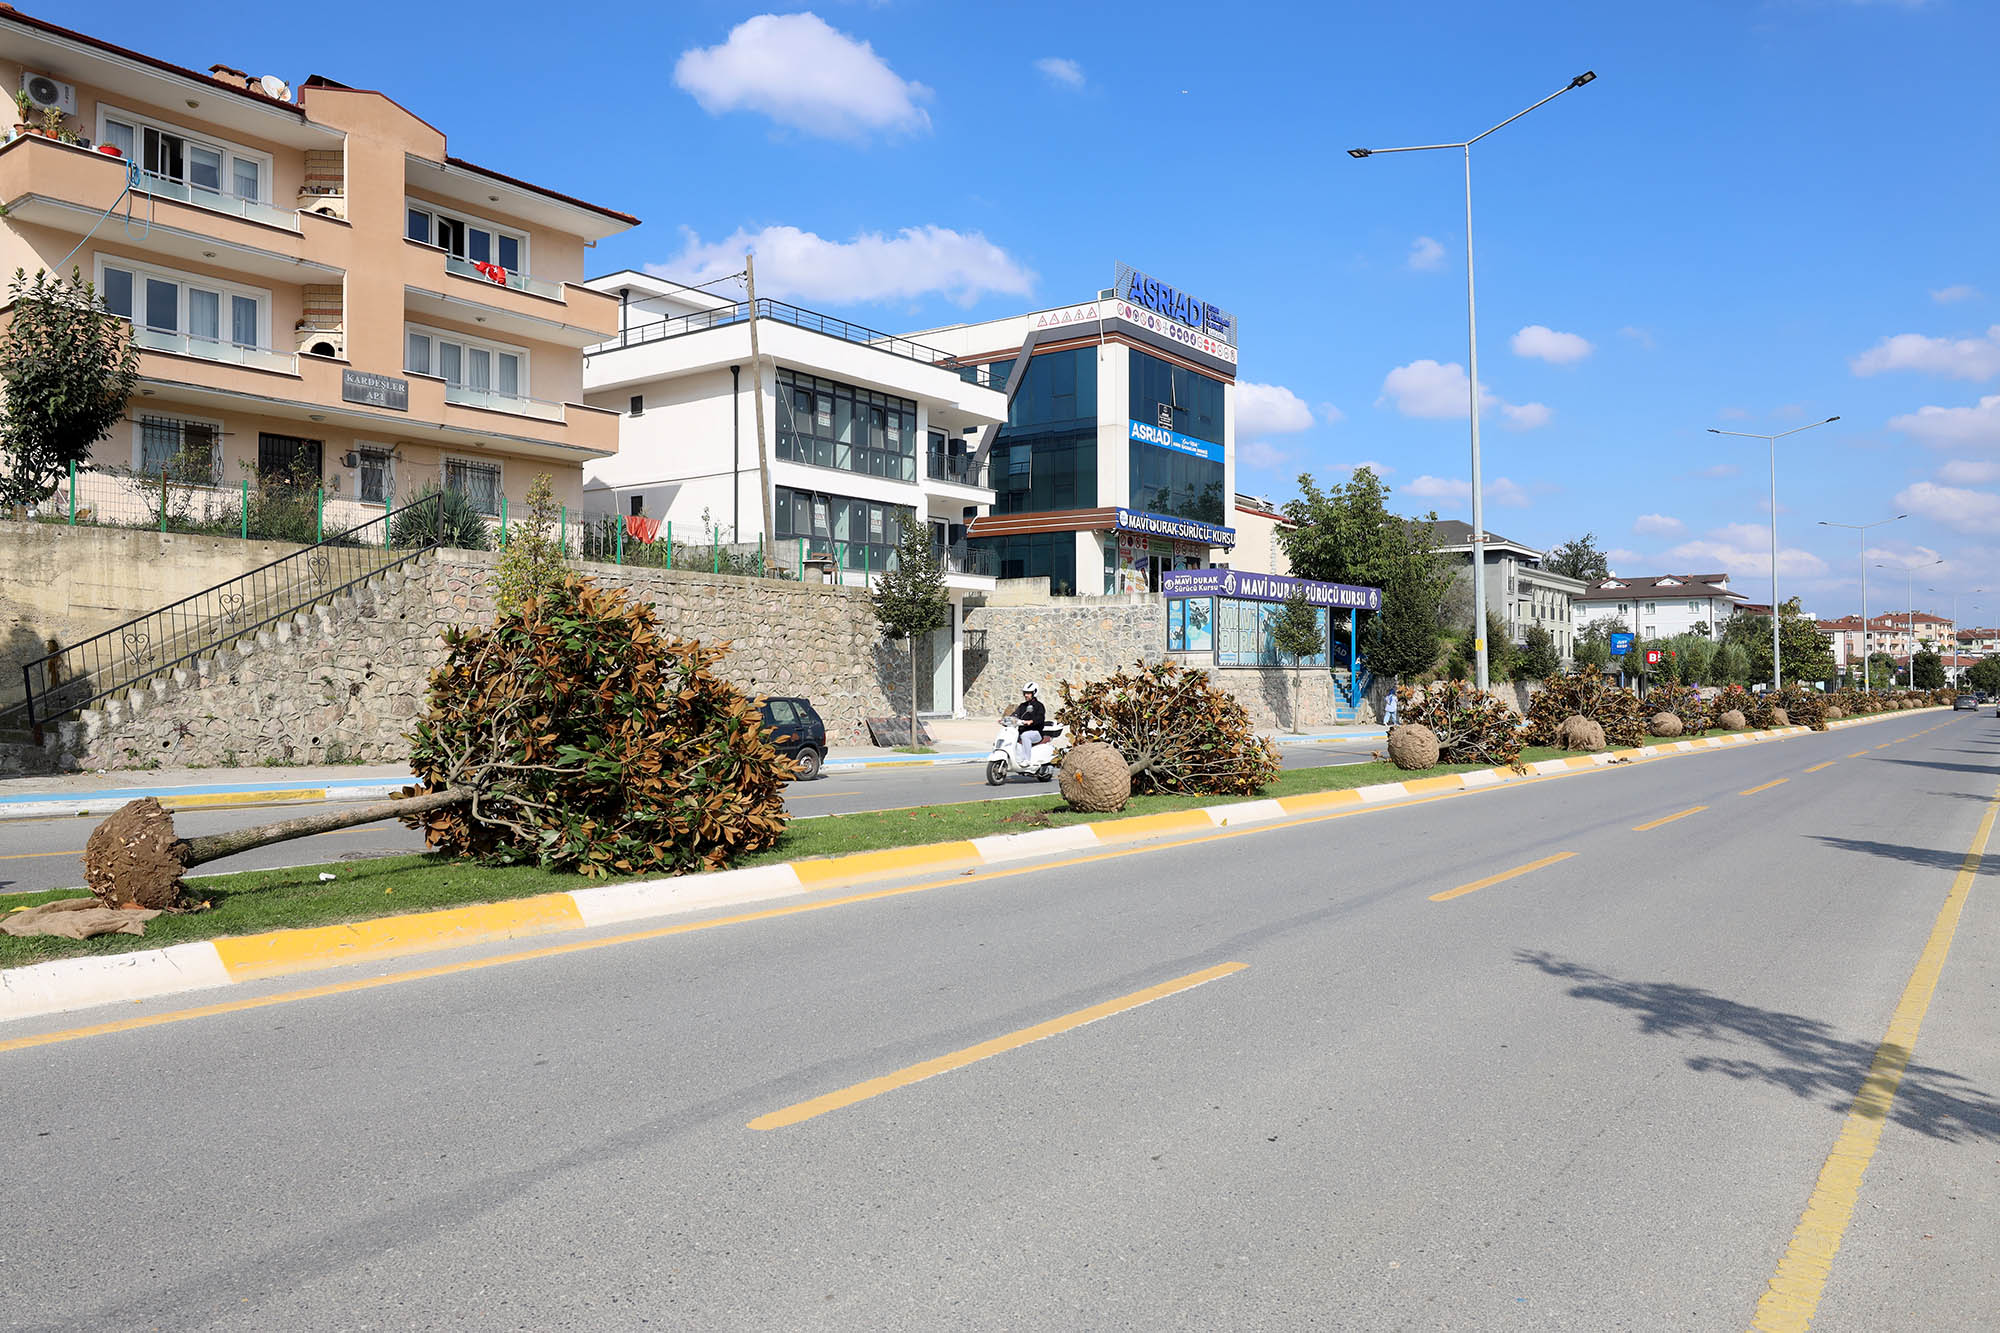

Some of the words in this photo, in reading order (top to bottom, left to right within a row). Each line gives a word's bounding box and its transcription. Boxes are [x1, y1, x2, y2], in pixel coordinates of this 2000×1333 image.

[346, 374, 406, 392] KARDEŞLER
[1131, 422, 1171, 446] ASRIAD
[1128, 514, 1149, 530] MAVİ
[1149, 519, 1177, 536] DURAK
[1179, 521, 1209, 541] SÜRÜCÜ
[1212, 529, 1236, 545] KURSU
[1174, 576, 1192, 585] MAVİ
[1193, 576, 1218, 585] DURAK
[1174, 584, 1198, 593] Sürücü
[1198, 584, 1218, 592] Kursu
[1240, 576, 1268, 596] MAVİ
[1305, 583, 1339, 604] SÜRÜCÜ
[1340, 590, 1366, 606] KURSU
